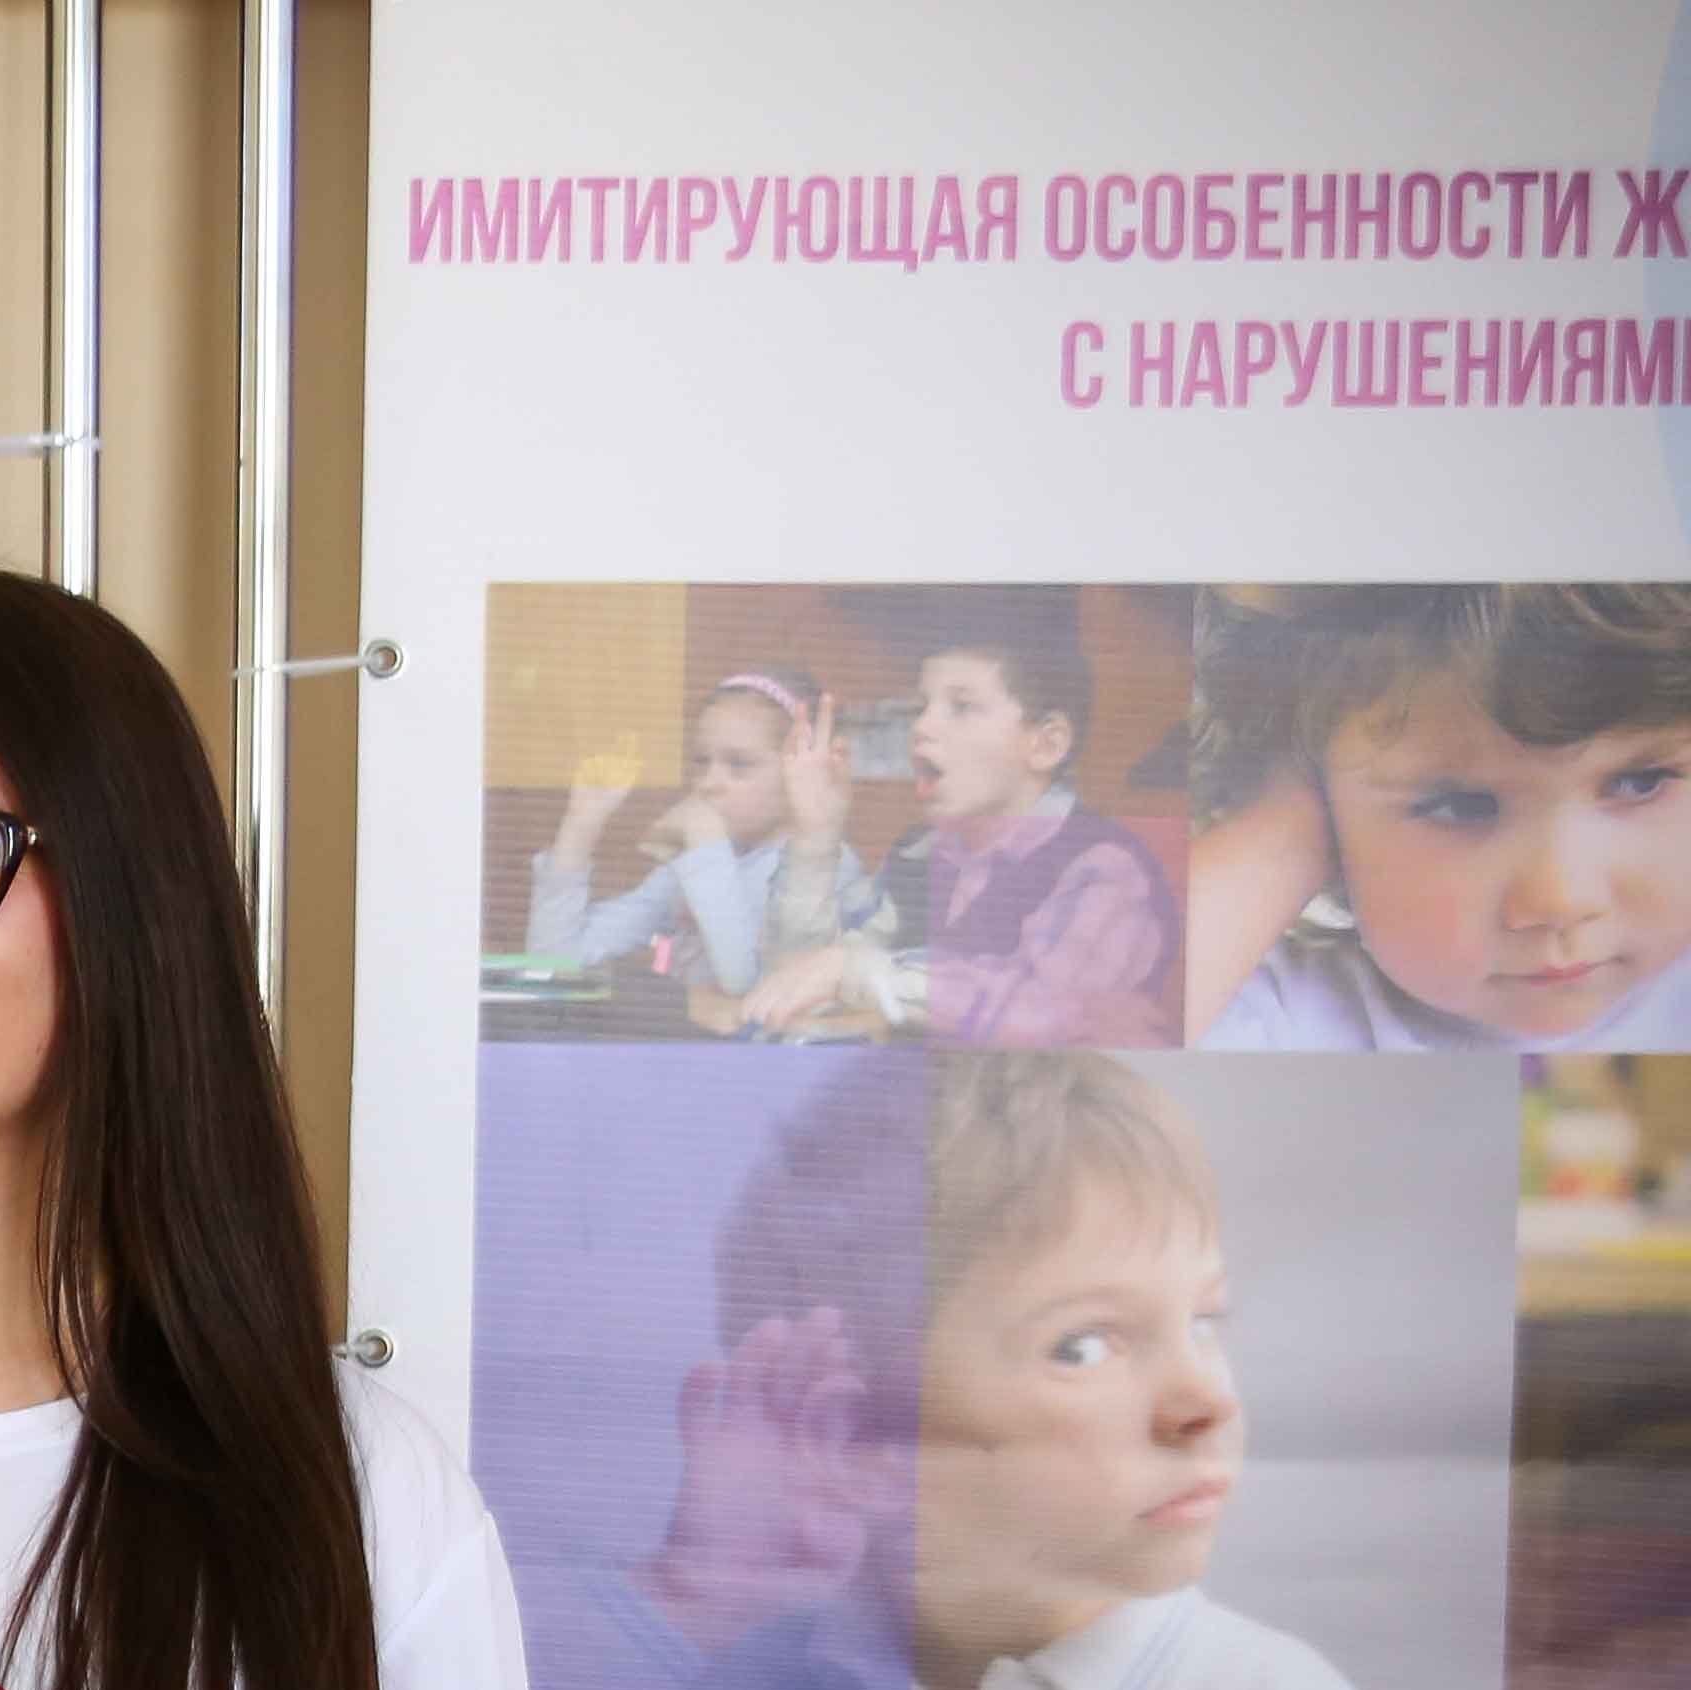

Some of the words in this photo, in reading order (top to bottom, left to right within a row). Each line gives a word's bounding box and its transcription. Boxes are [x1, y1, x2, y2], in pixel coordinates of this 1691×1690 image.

[408, 174, 1020, 273] ИМИТИРУЮЩАЯ
[1043, 169, 1591, 261] ОСОБЕННОСТИ
[1614, 168, 1691, 259] Ж
[1060, 320, 1105, 411] С
[1128, 317, 1691, 409] НАРУШЕНИЯМ
